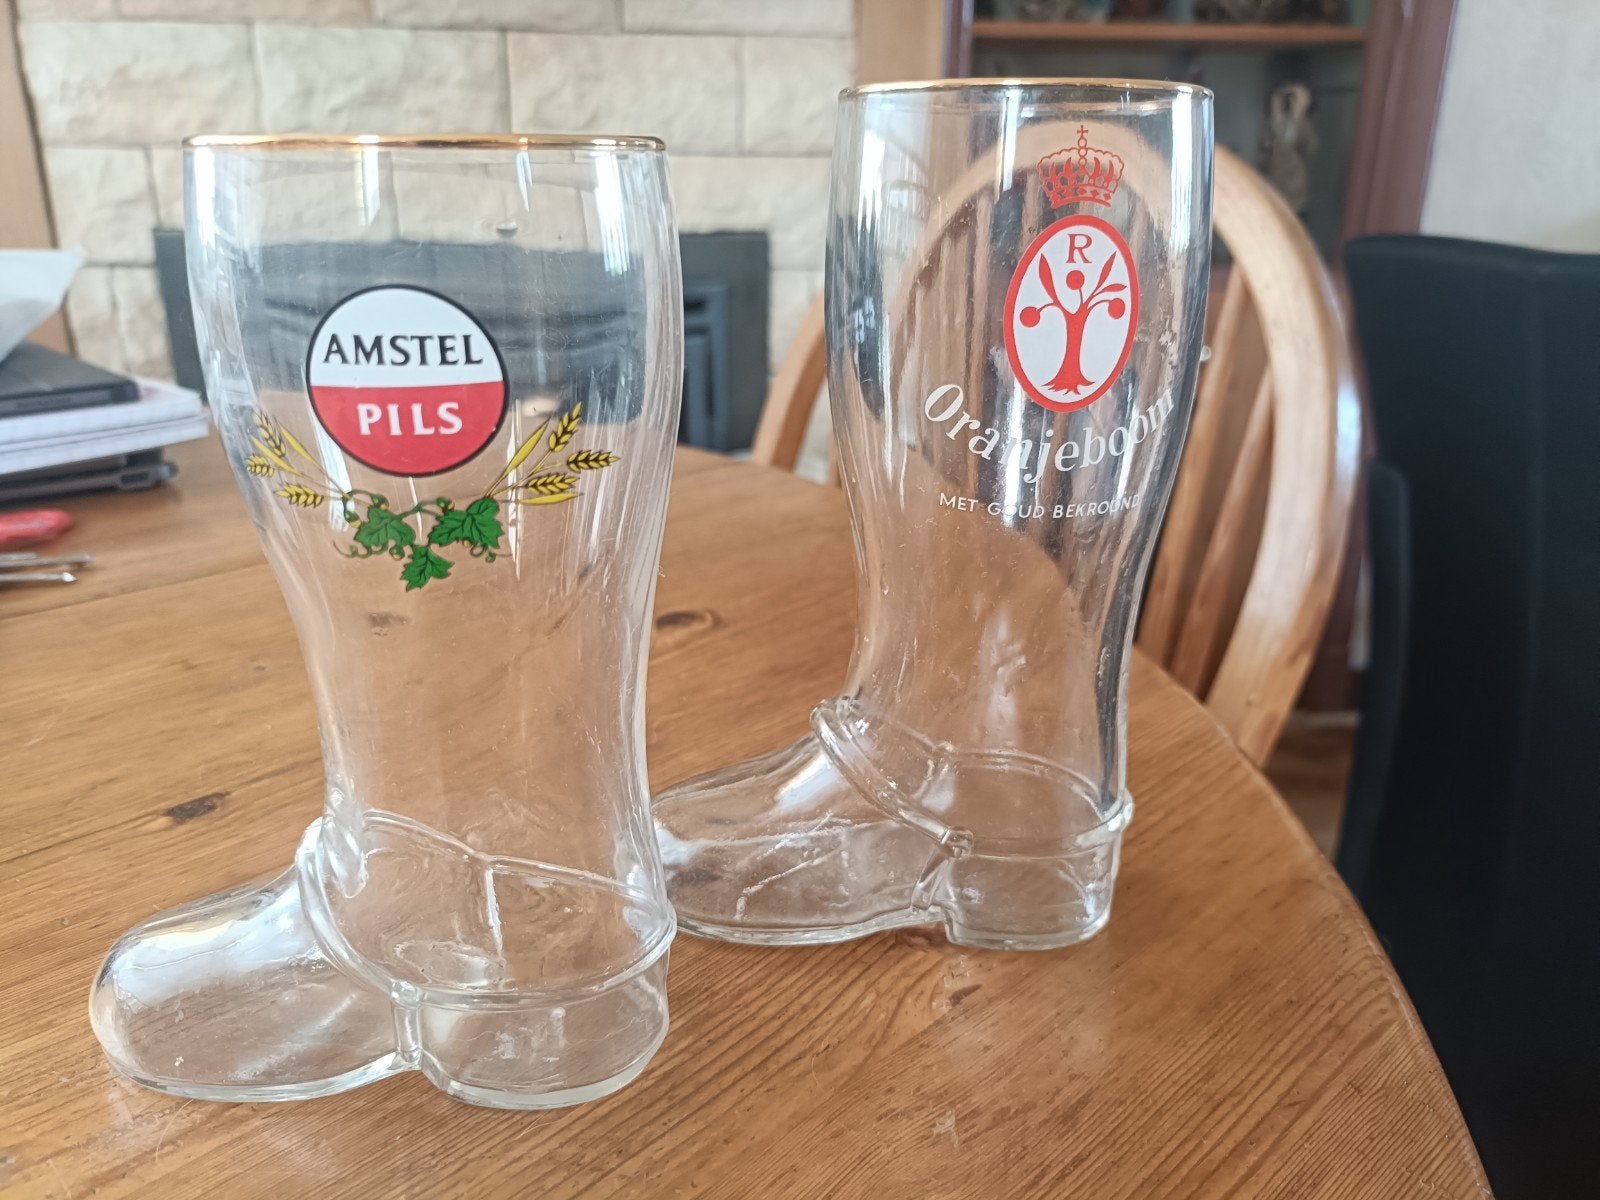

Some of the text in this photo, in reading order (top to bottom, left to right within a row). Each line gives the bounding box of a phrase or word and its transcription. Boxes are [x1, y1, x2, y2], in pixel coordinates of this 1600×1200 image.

[1065, 232, 1093, 264] R
[322, 333, 484, 367] AMSTEL
[356, 401, 463, 436] PILS
[924, 383, 1175, 484] Oranjeboom
[938, 492, 1142, 520] MET GOUD BEKROOND
